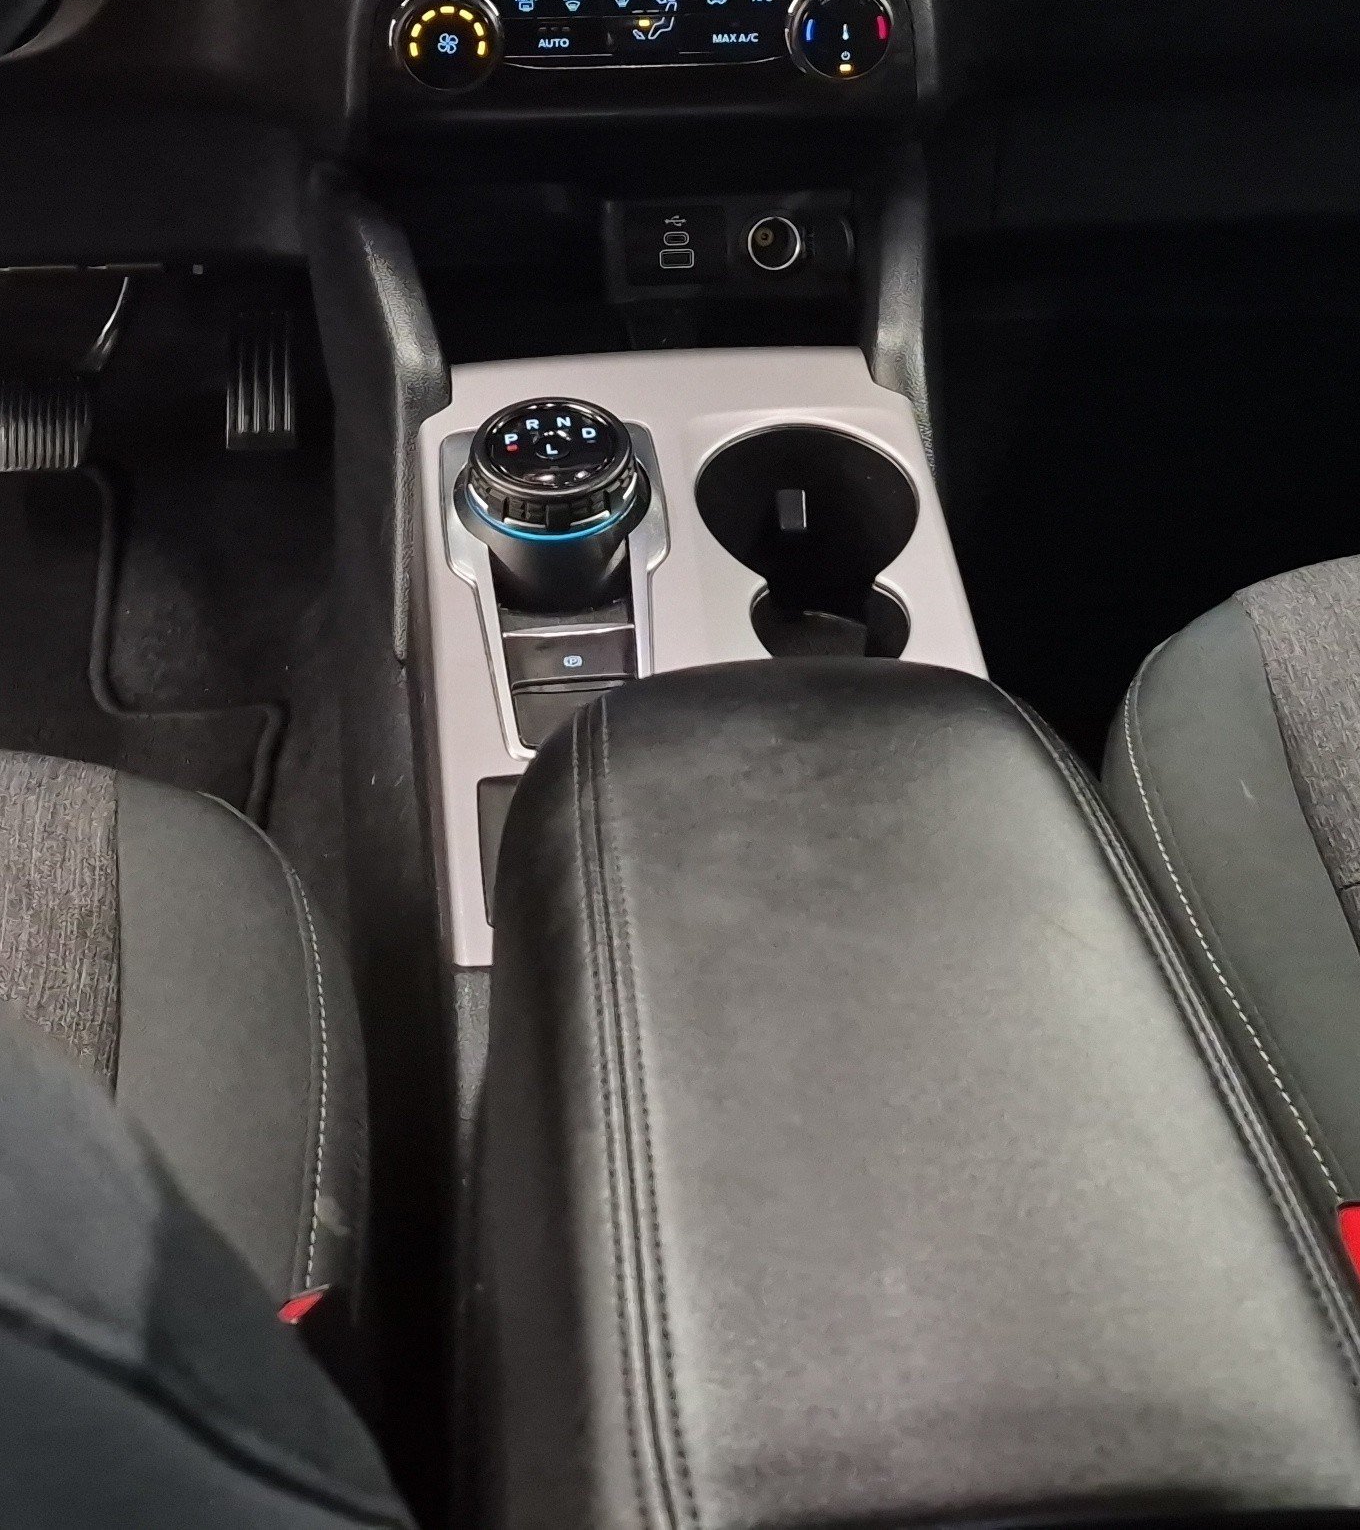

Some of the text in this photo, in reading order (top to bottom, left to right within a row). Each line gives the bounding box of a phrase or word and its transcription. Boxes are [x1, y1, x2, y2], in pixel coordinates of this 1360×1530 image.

[538, 38, 569, 48] AUTO
[712, 33, 759, 43] MAX A/C
[525, 419, 539, 430] R
[556, 417, 571, 427] N
[581, 428, 596, 438] D
[504, 434, 518, 444] P
[546, 444, 558, 454] L
